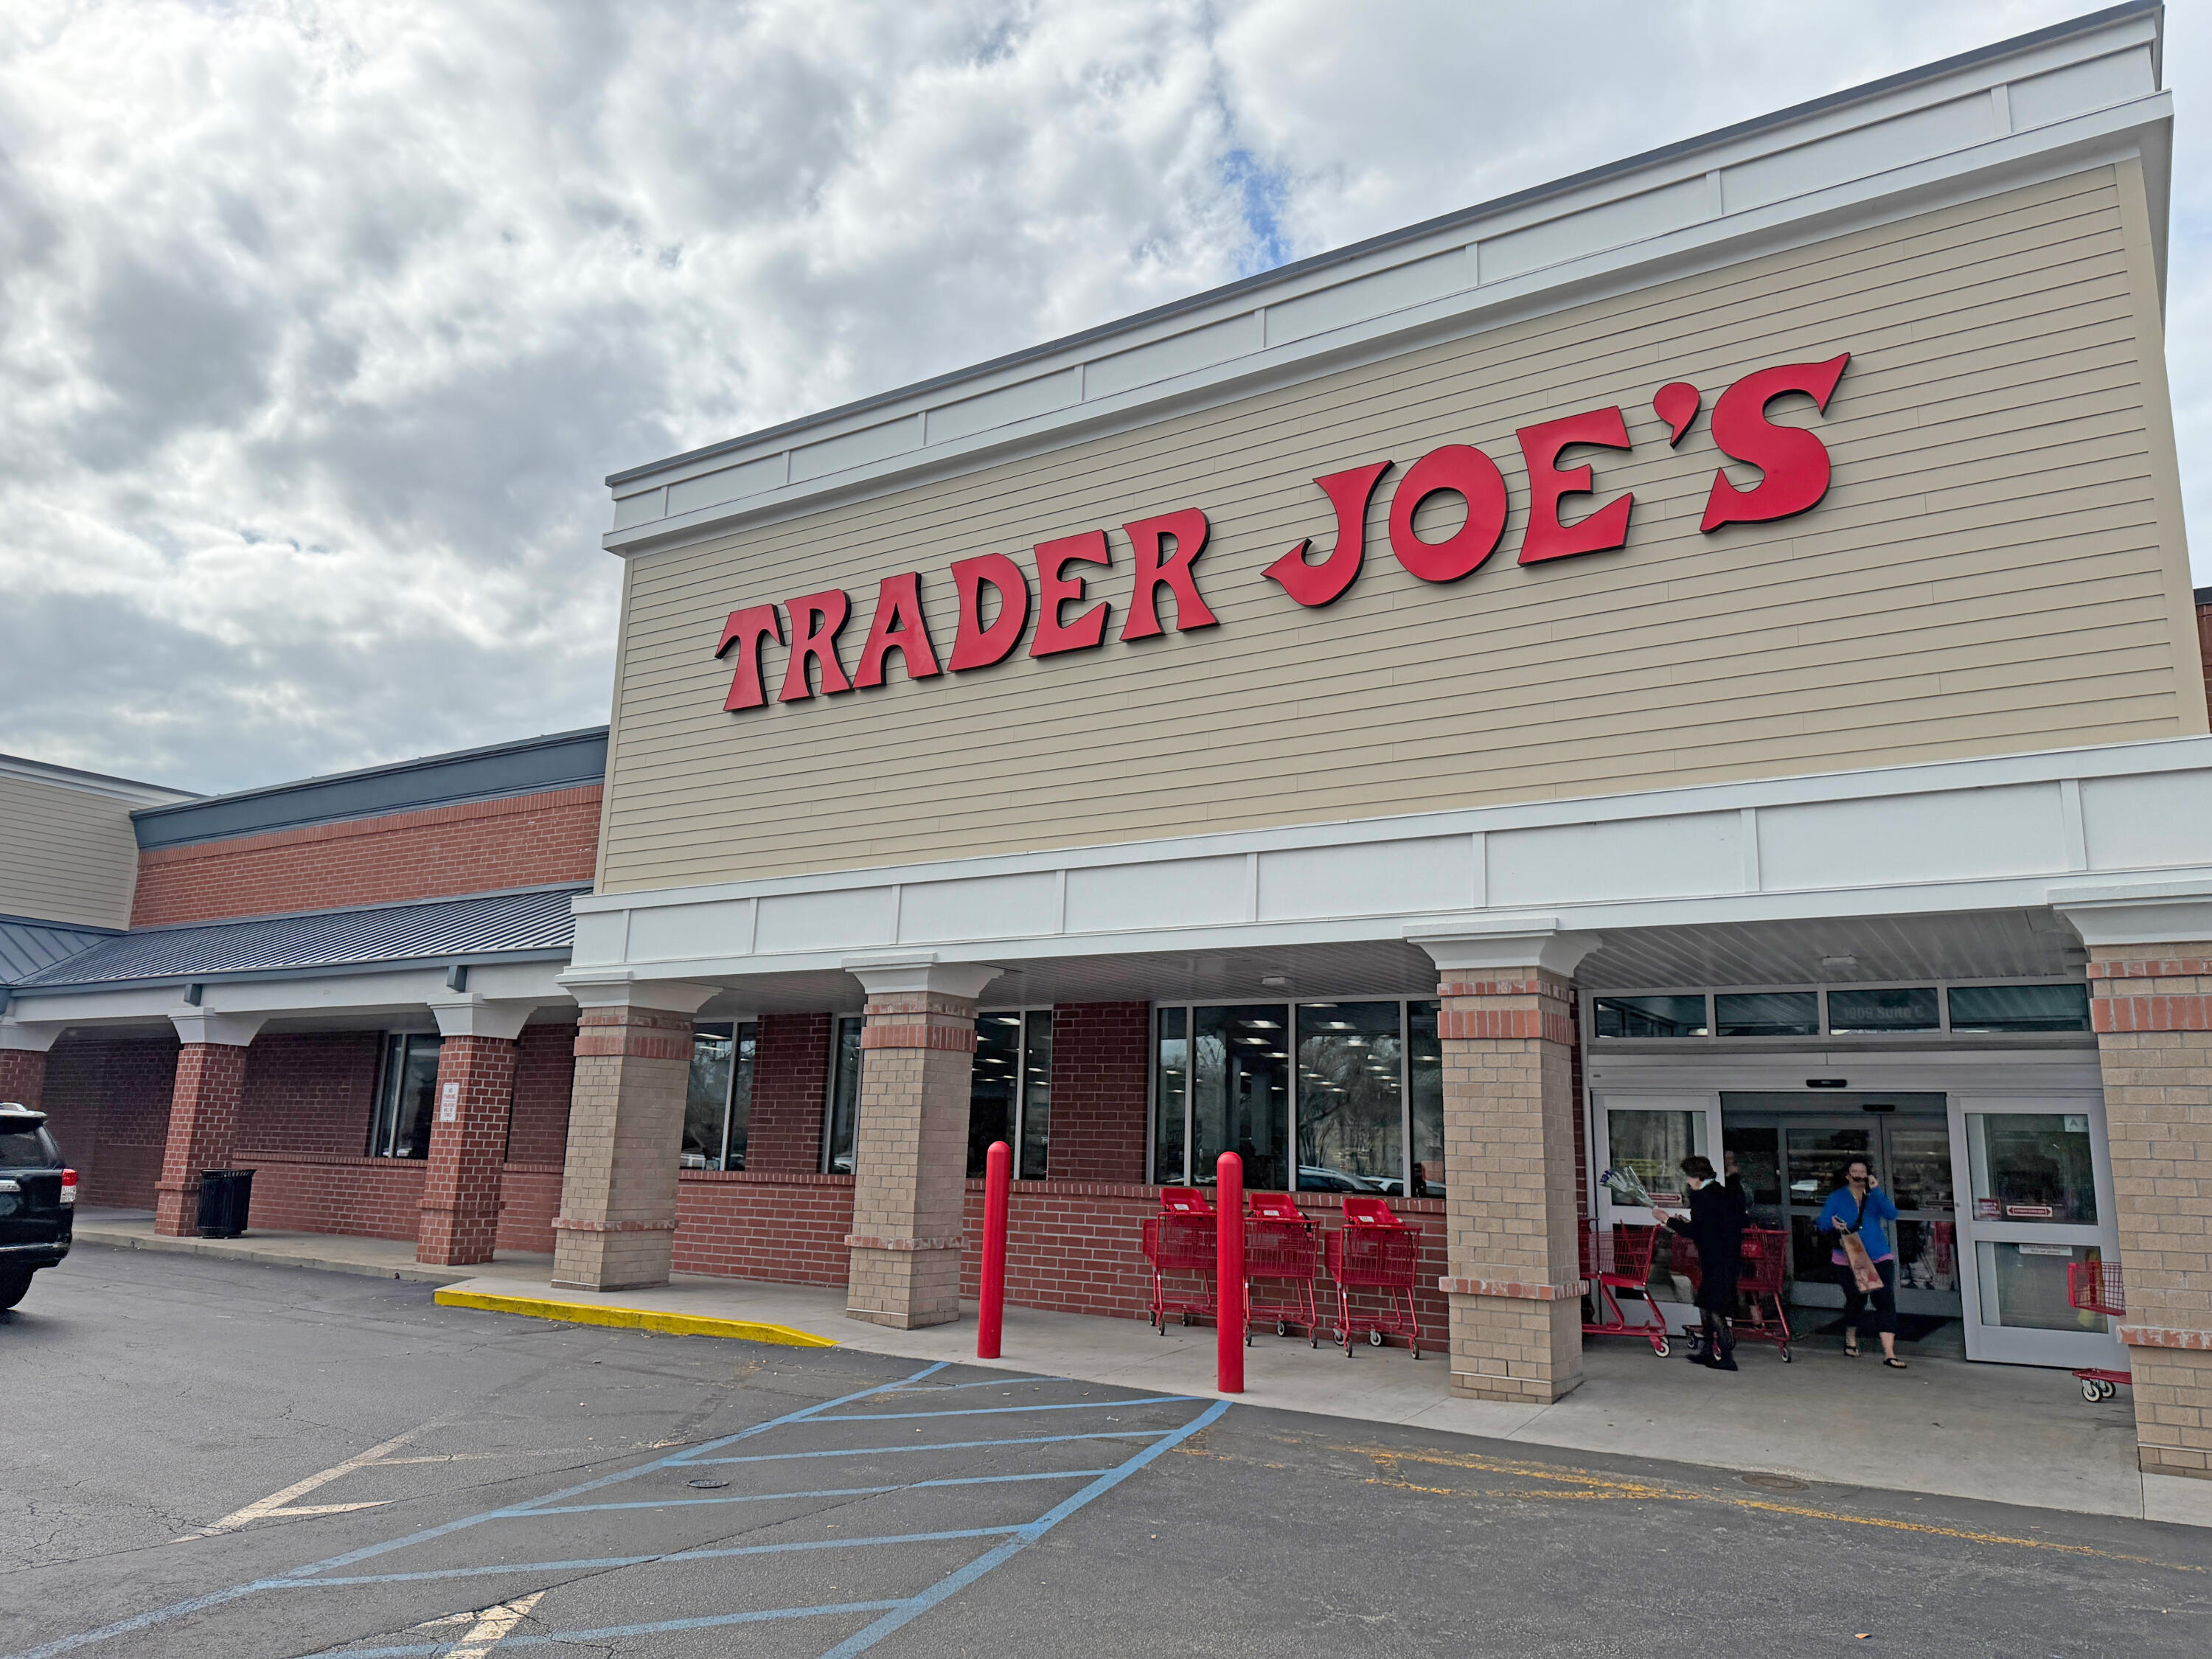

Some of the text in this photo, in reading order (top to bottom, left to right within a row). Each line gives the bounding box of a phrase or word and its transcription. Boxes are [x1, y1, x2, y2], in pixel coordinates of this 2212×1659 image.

[714, 352, 1851, 712] TRADER JOE'S
[1843, 1007, 1873, 1019] 1909
[1876, 1005, 1912, 1019] Suite
[2070, 1117, 2079, 1127] A
